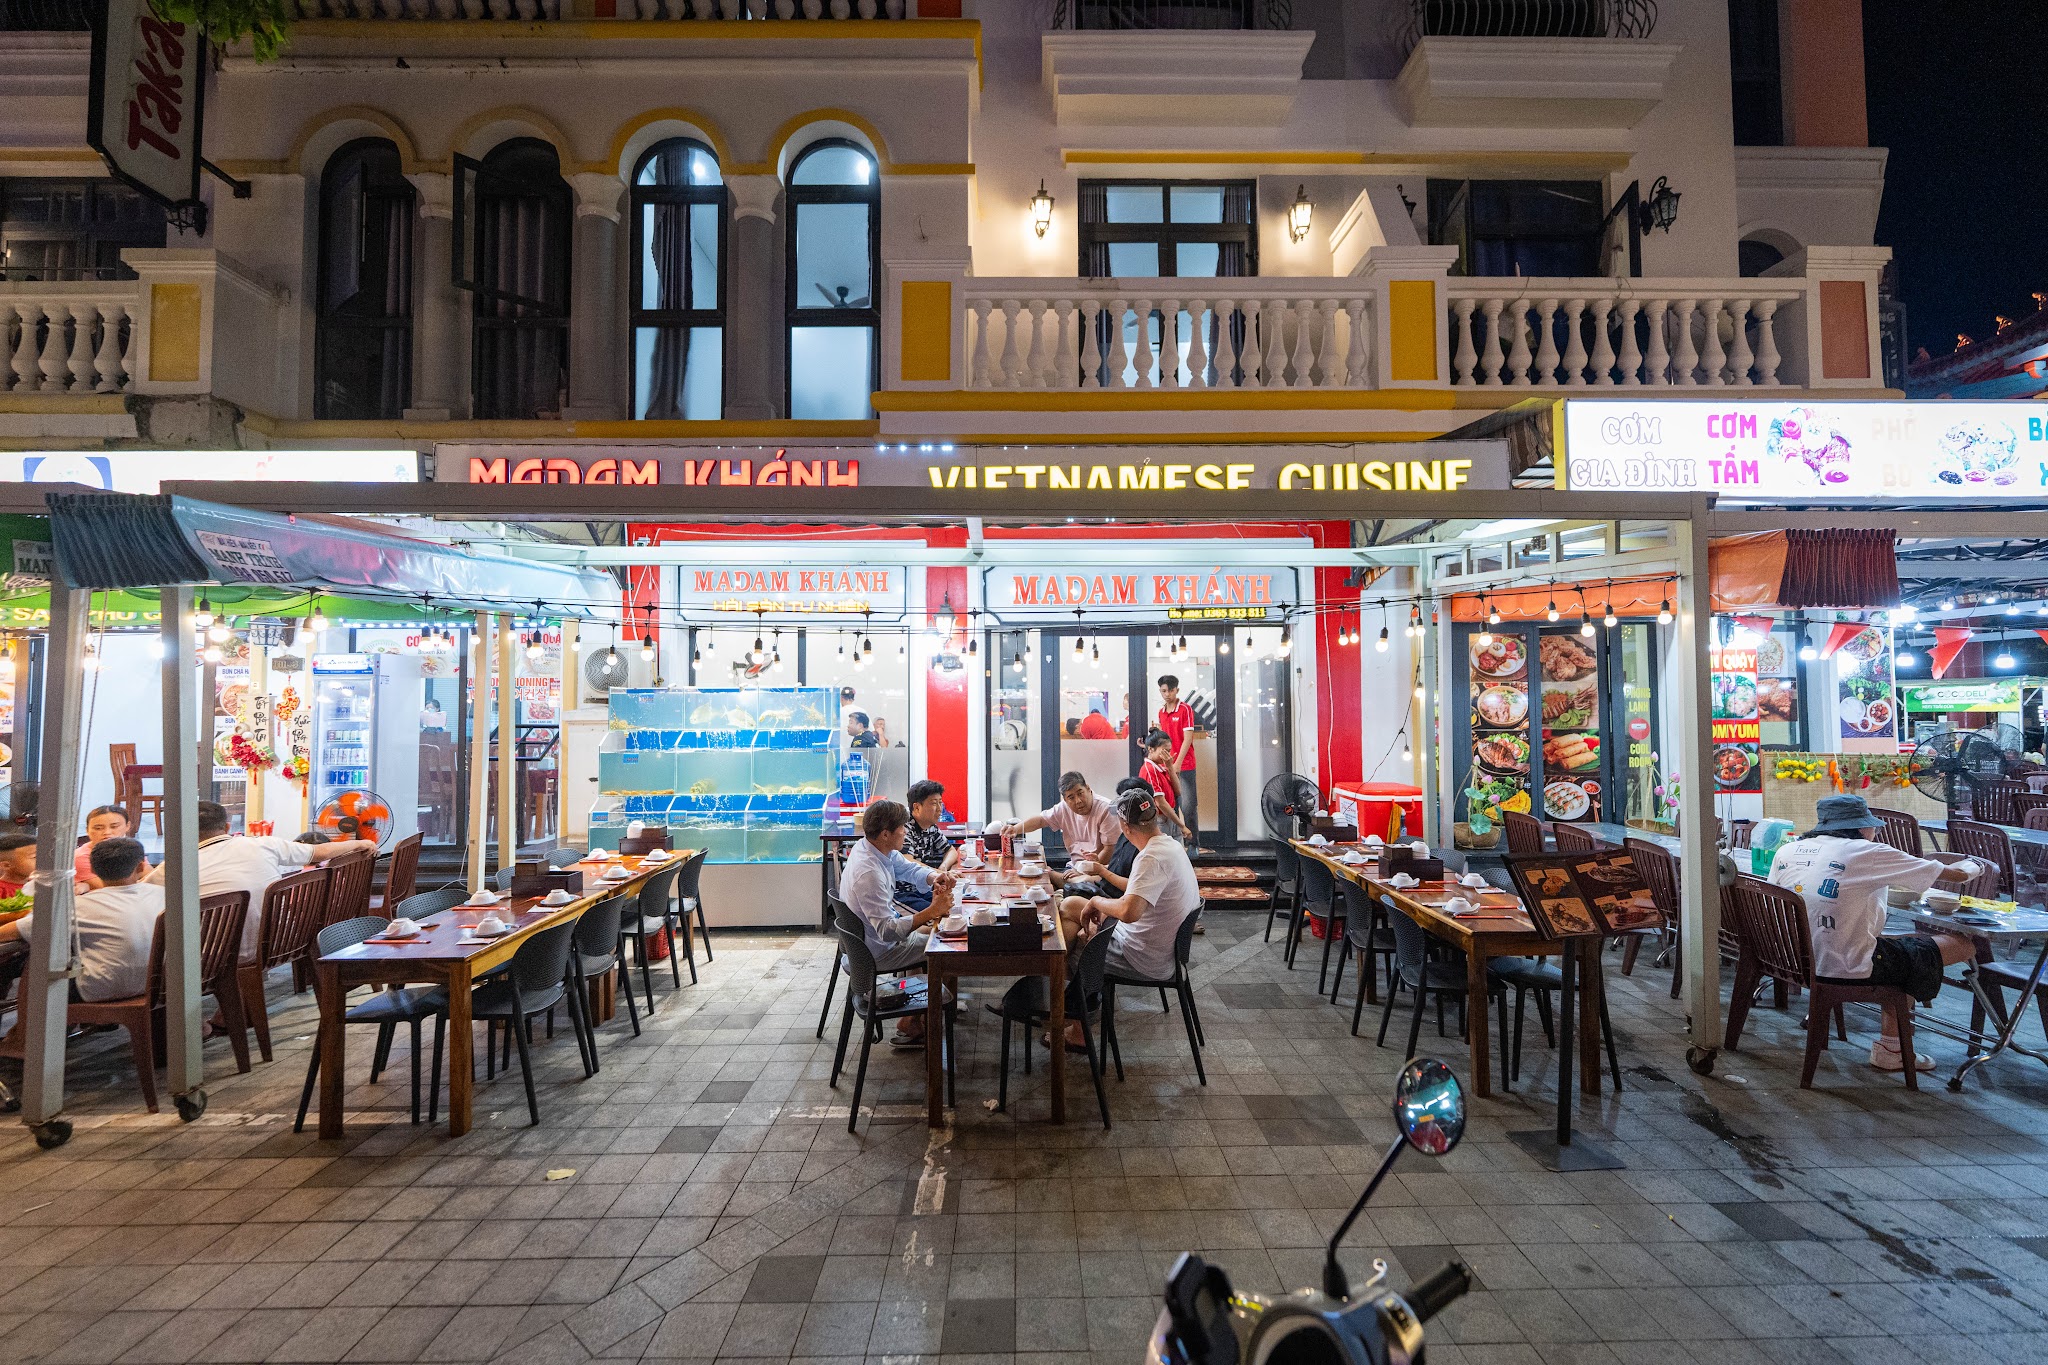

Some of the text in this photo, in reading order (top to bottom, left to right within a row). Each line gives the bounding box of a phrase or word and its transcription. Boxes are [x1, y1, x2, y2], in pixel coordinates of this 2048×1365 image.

[1707, 412, 1757, 439] CƠM
[469, 448, 860, 487] MADAM KHÁNH
[928, 459, 1472, 491] VIETNAMESE CUISINE
[1570, 459, 1620, 487] GIA
[1709, 444, 1759, 484] TẤM
[694, 565, 889, 592] MADAM KHÁNH
[1013, 566, 1272, 605] MADAM KHÁNH
[1248, 608, 1266, 617] 811
[1723, 652, 1756, 671] QUẬY
[1937, 690, 1987, 698] COCODELI
[1629, 756, 1652, 768] ROOM
[1630, 743, 1650, 755] COOL
[1796, 844, 1823, 854] Travel
